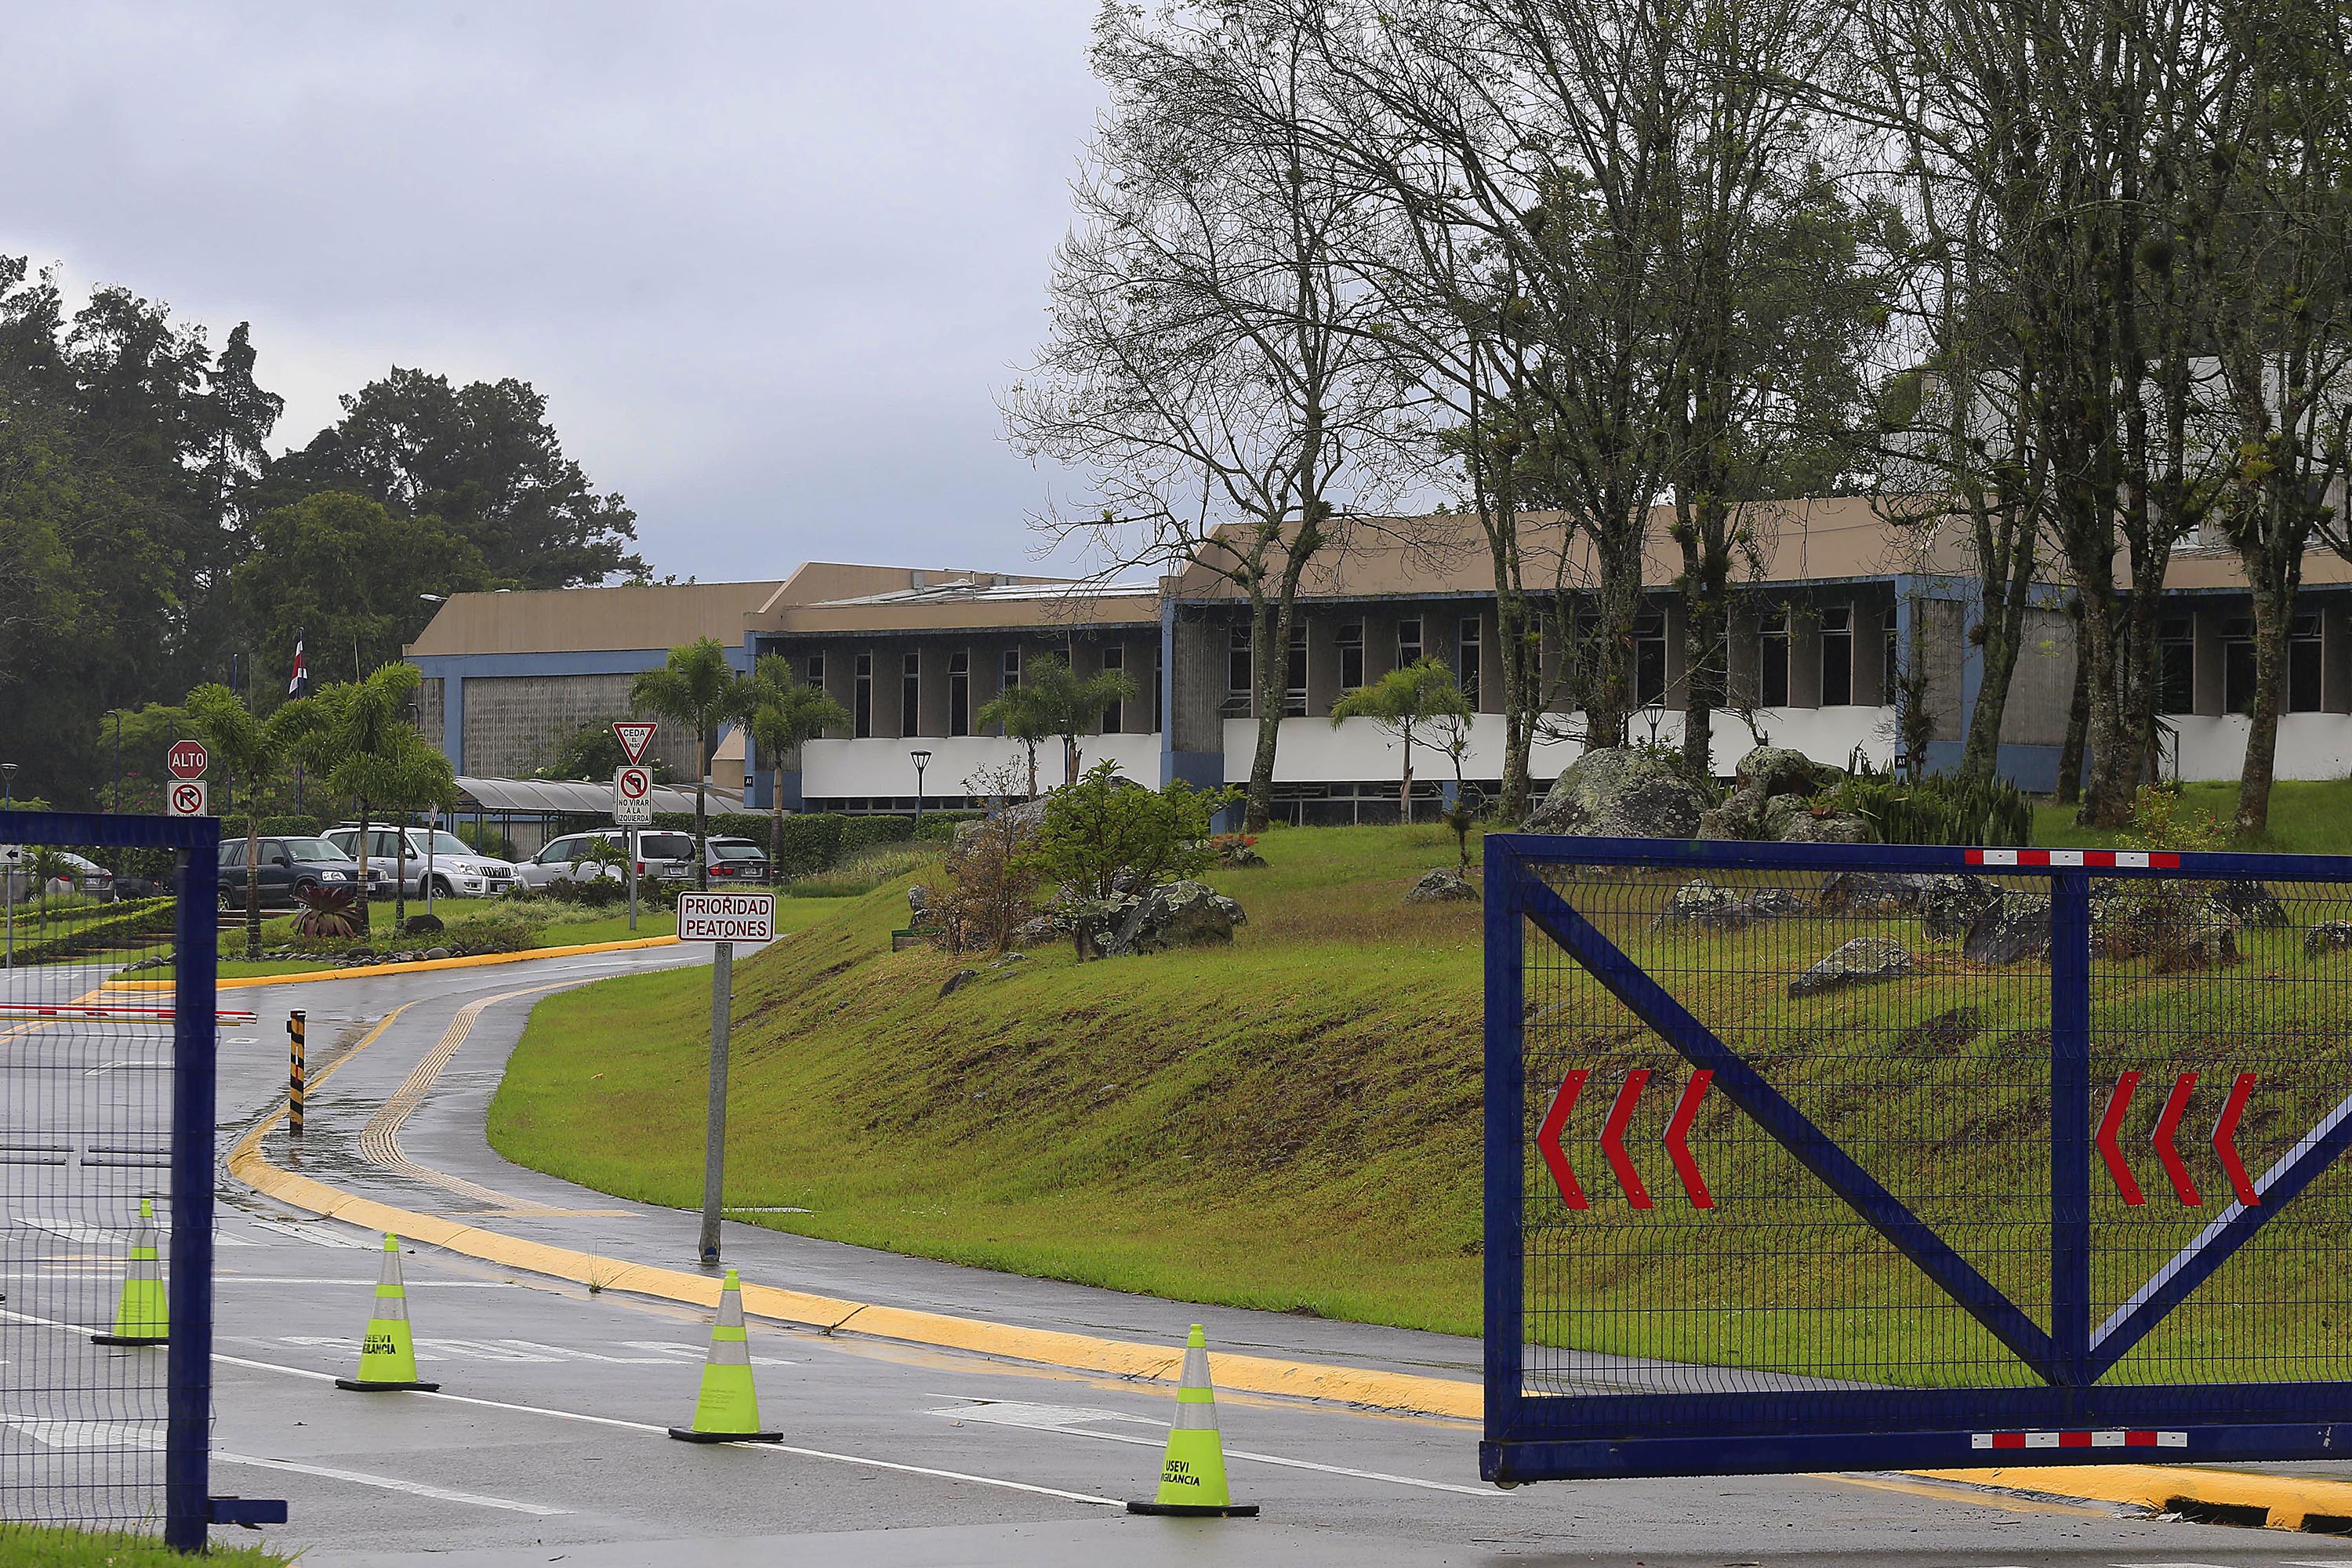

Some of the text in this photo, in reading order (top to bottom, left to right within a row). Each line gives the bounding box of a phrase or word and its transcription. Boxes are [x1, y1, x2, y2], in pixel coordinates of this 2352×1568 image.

[623, 728, 645, 737] CEDA
[172, 753, 204, 767] ALTO
[685, 898, 769, 915] PRIORIDAD
[686, 920, 767, 936] PEATONES
[1166, 1460, 1189, 1473] USEVI
